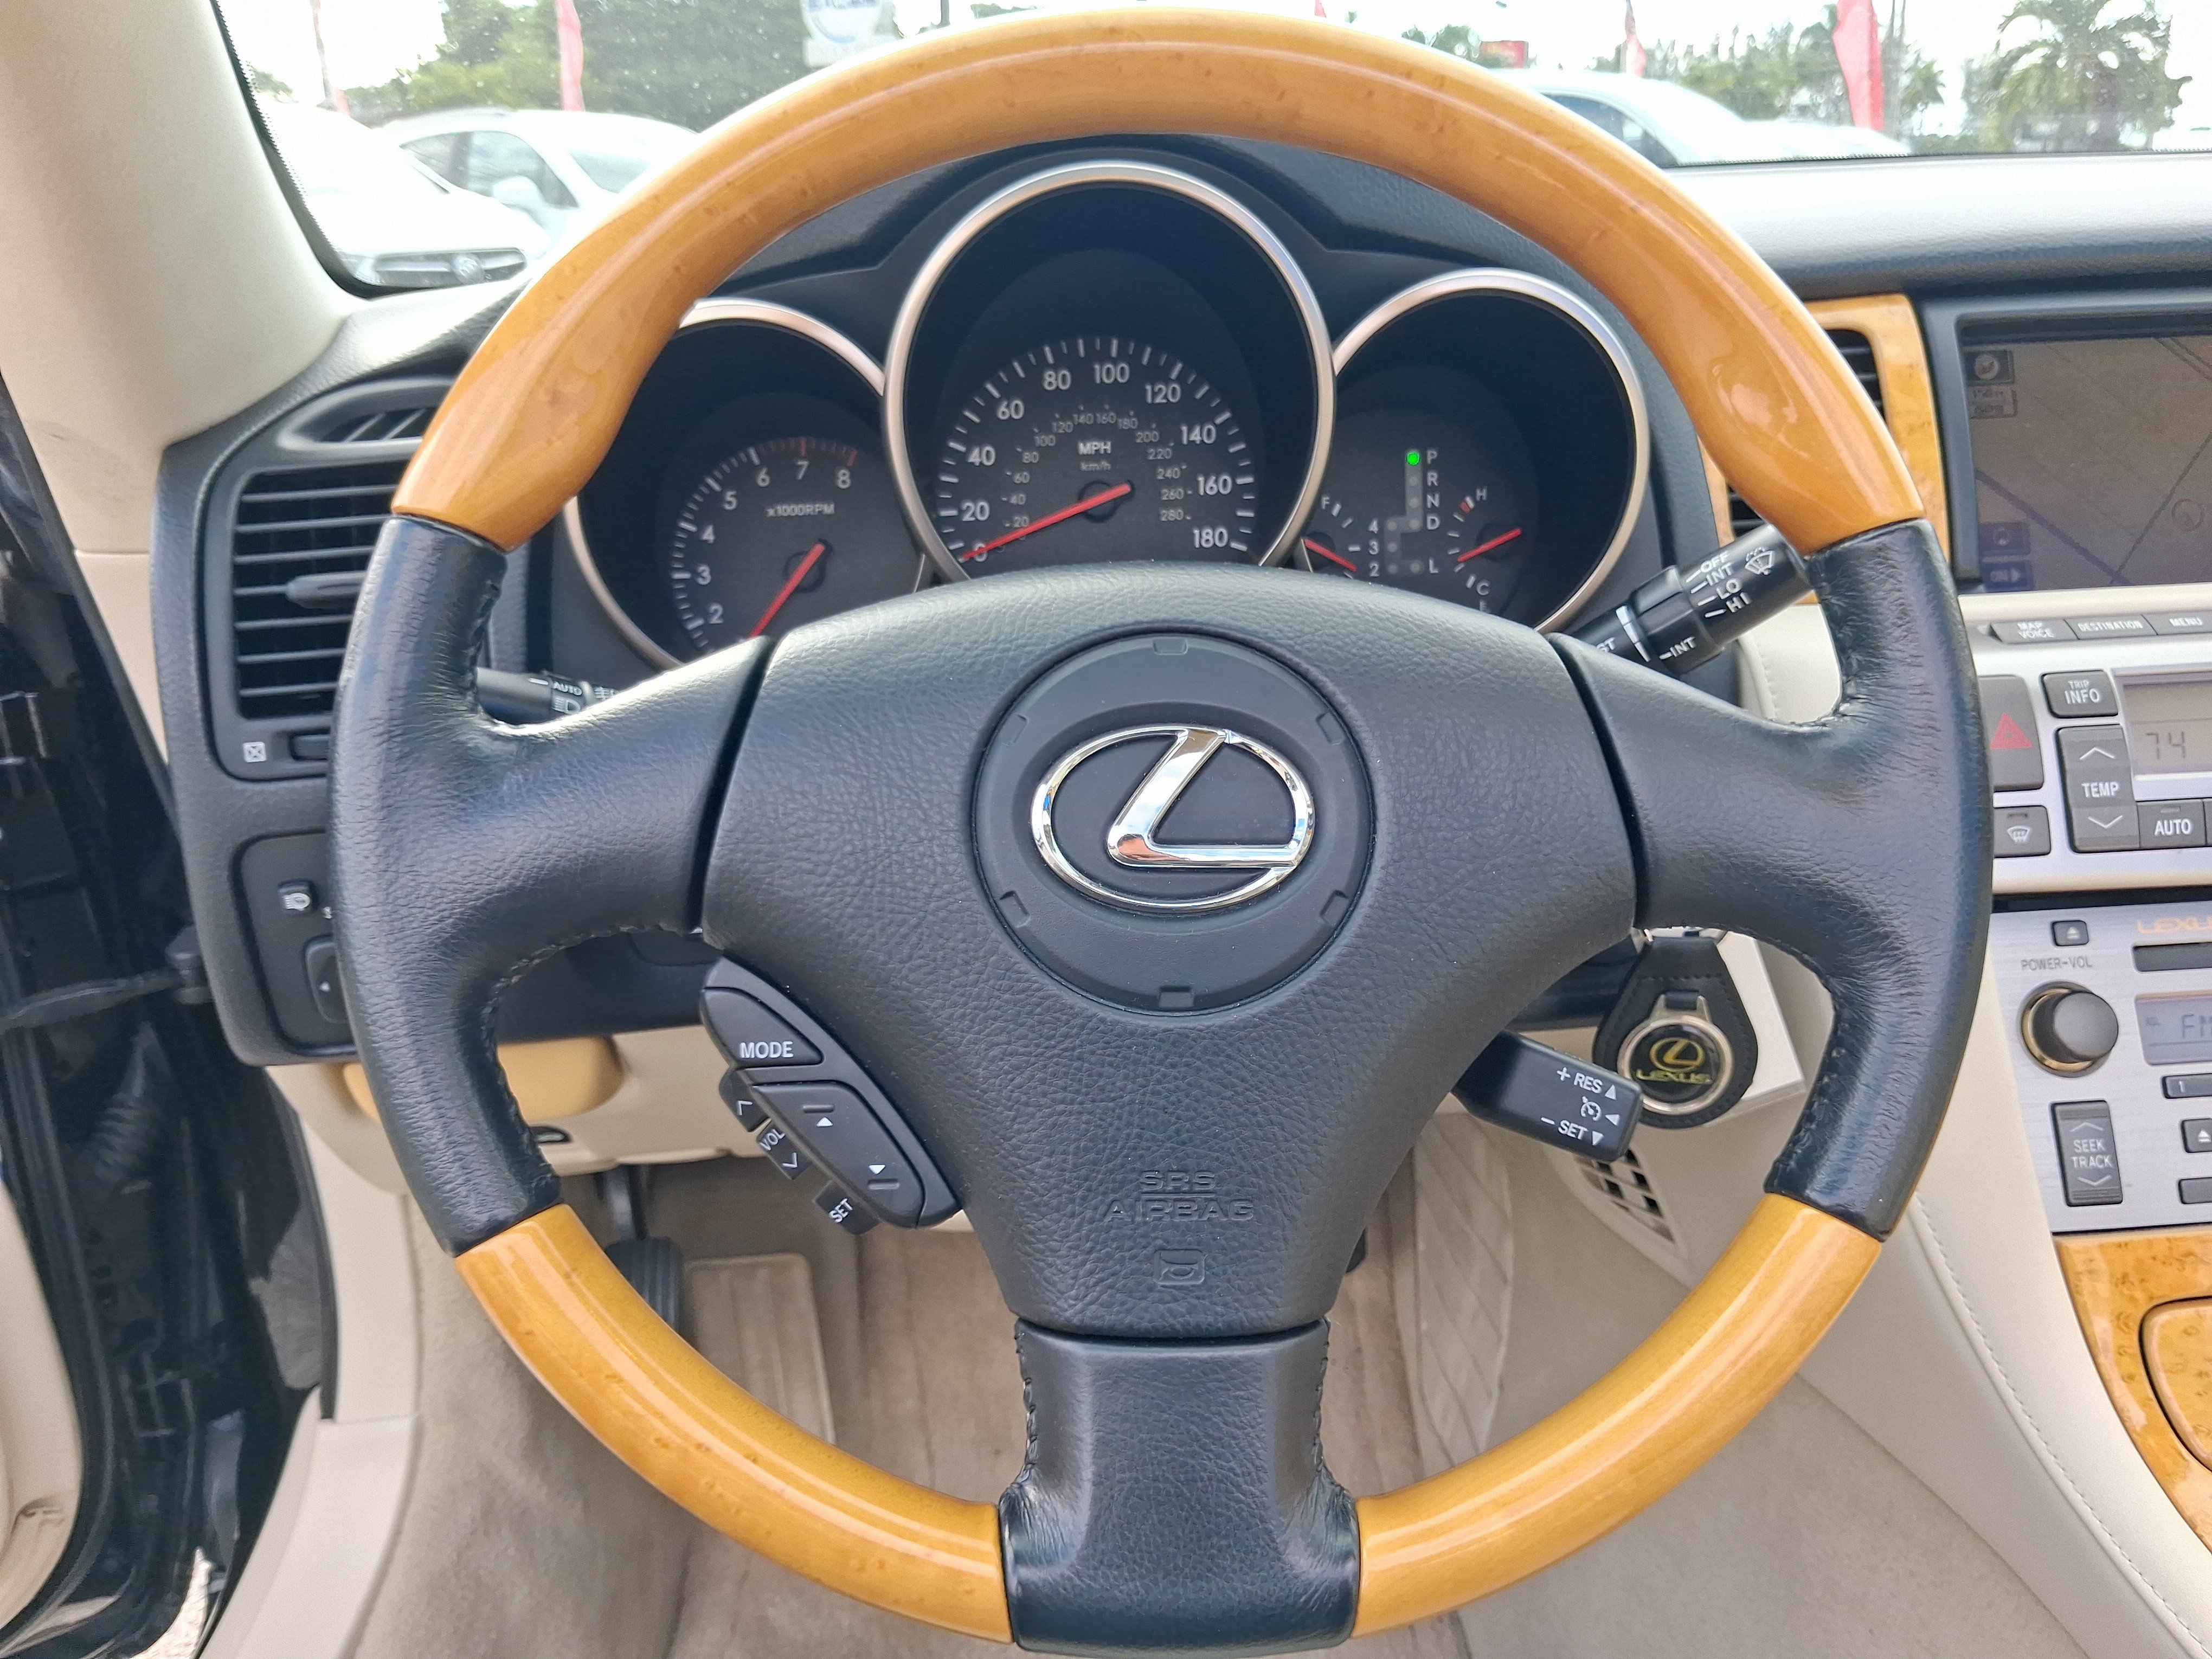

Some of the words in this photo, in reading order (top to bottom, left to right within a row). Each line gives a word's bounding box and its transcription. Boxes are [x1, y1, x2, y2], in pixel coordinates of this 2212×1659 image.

[1043, 370, 1071, 391] 80
[1094, 363, 1130, 384] 100
[1145, 384, 1181, 404] 120
[996, 400, 1025, 420] 60
[1096, 412, 1117, 424] 160
[1052, 421, 1073, 433] 120
[1073, 413, 1094, 425] 140
[1117, 417, 1139, 430] 180
[1034, 435, 1056, 447] 100
[1136, 431, 1159, 443] 200
[1181, 423, 1216, 445] 140
[967, 446, 996, 466] 40
[1078, 441, 1111, 455] MPH
[1147, 448, 1172, 460] 220
[1022, 452, 1039, 463] 80
[1427, 449, 1438, 464] P
[757, 467, 770, 487] 6
[796, 460, 809, 479] 7
[1157, 467, 1180, 479] 240
[837, 469, 851, 488] 8
[1013, 472, 1030, 484] 60
[1197, 475, 1232, 496] 160
[1427, 472, 1438, 486] R
[724, 492, 737, 510] 5
[1009, 493, 1026, 506] 40
[1427, 493, 1440, 508] N
[1476, 487, 1488, 501] H
[1321, 495, 1330, 510] F
[961, 500, 989, 522] 20
[1368, 518, 1379, 534] 4
[1426, 515, 1441, 530] D
[702, 525, 715, 543] 4
[1193, 528, 1228, 548] 180
[1369, 541, 1379, 555] 3
[1369, 563, 1380, 577] 2
[1429, 558, 1438, 574] L
[1700, 552, 1729, 573] OFF
[696, 565, 711, 585] 3
[1706, 563, 1734, 586] INT
[1477, 581, 1489, 595] C
[1716, 579, 1741, 600] LO
[1726, 592, 1752, 613] HI
[709, 605, 723, 623] 2
[2169, 617, 2203, 627] MENU
[2018, 629, 2054, 639] VOICE
[2078, 620, 2143, 632] DESTINATION
[1670, 637, 1696, 657] INT
[2068, 680, 2089, 689] TRIP
[2064, 688, 2100, 704] INFO
[2146, 730, 2185, 760] 74
[2081, 782, 2119, 798] TEMP
[2155, 818, 2191, 835] AUTO
[2021, 956, 2093, 971] POWER-VOL
[740, 1041, 794, 1059] MODE
[1573, 1072, 1603, 1095] RES
[2178, 1081, 2185, 1093] 1
[1558, 1118, 1589, 1141] SET
[760, 1127, 786, 1151] VOL
[2073, 1139, 2107, 1153] SEEK
[2070, 1154, 2112, 1169] TRACK
[1140, 1171, 1216, 1190] SRS
[828, 1198, 854, 1223] SET
[1104, 1199, 1254, 1221] AIRBAG
